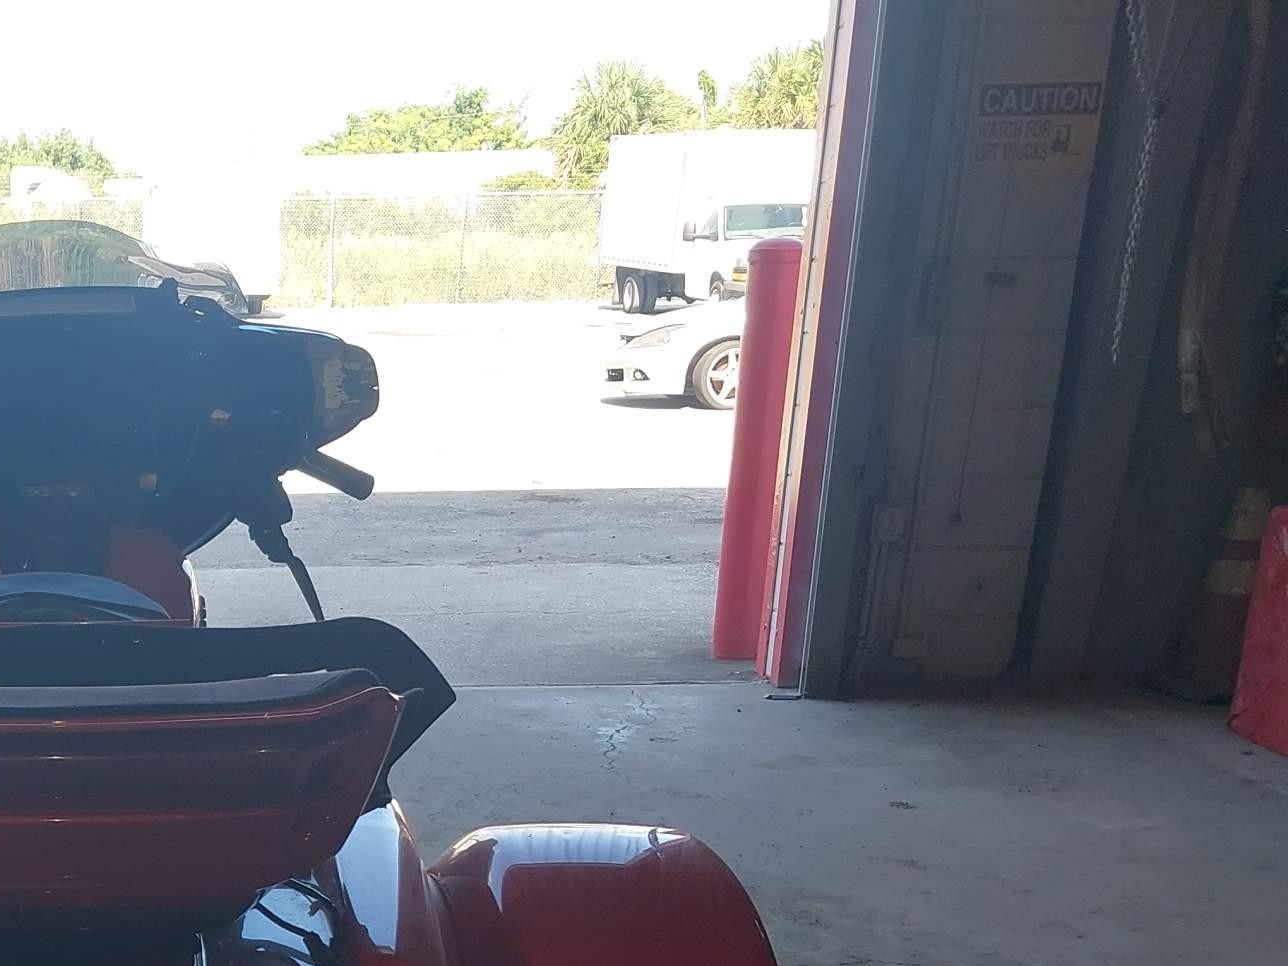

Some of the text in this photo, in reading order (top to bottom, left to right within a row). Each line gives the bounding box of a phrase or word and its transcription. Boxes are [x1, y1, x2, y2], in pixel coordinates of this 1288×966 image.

[983, 86, 1099, 114] CAUTION
[977, 118, 1050, 138] WATCH FOR
[974, 142, 1048, 162] LIFT TRUCKS
